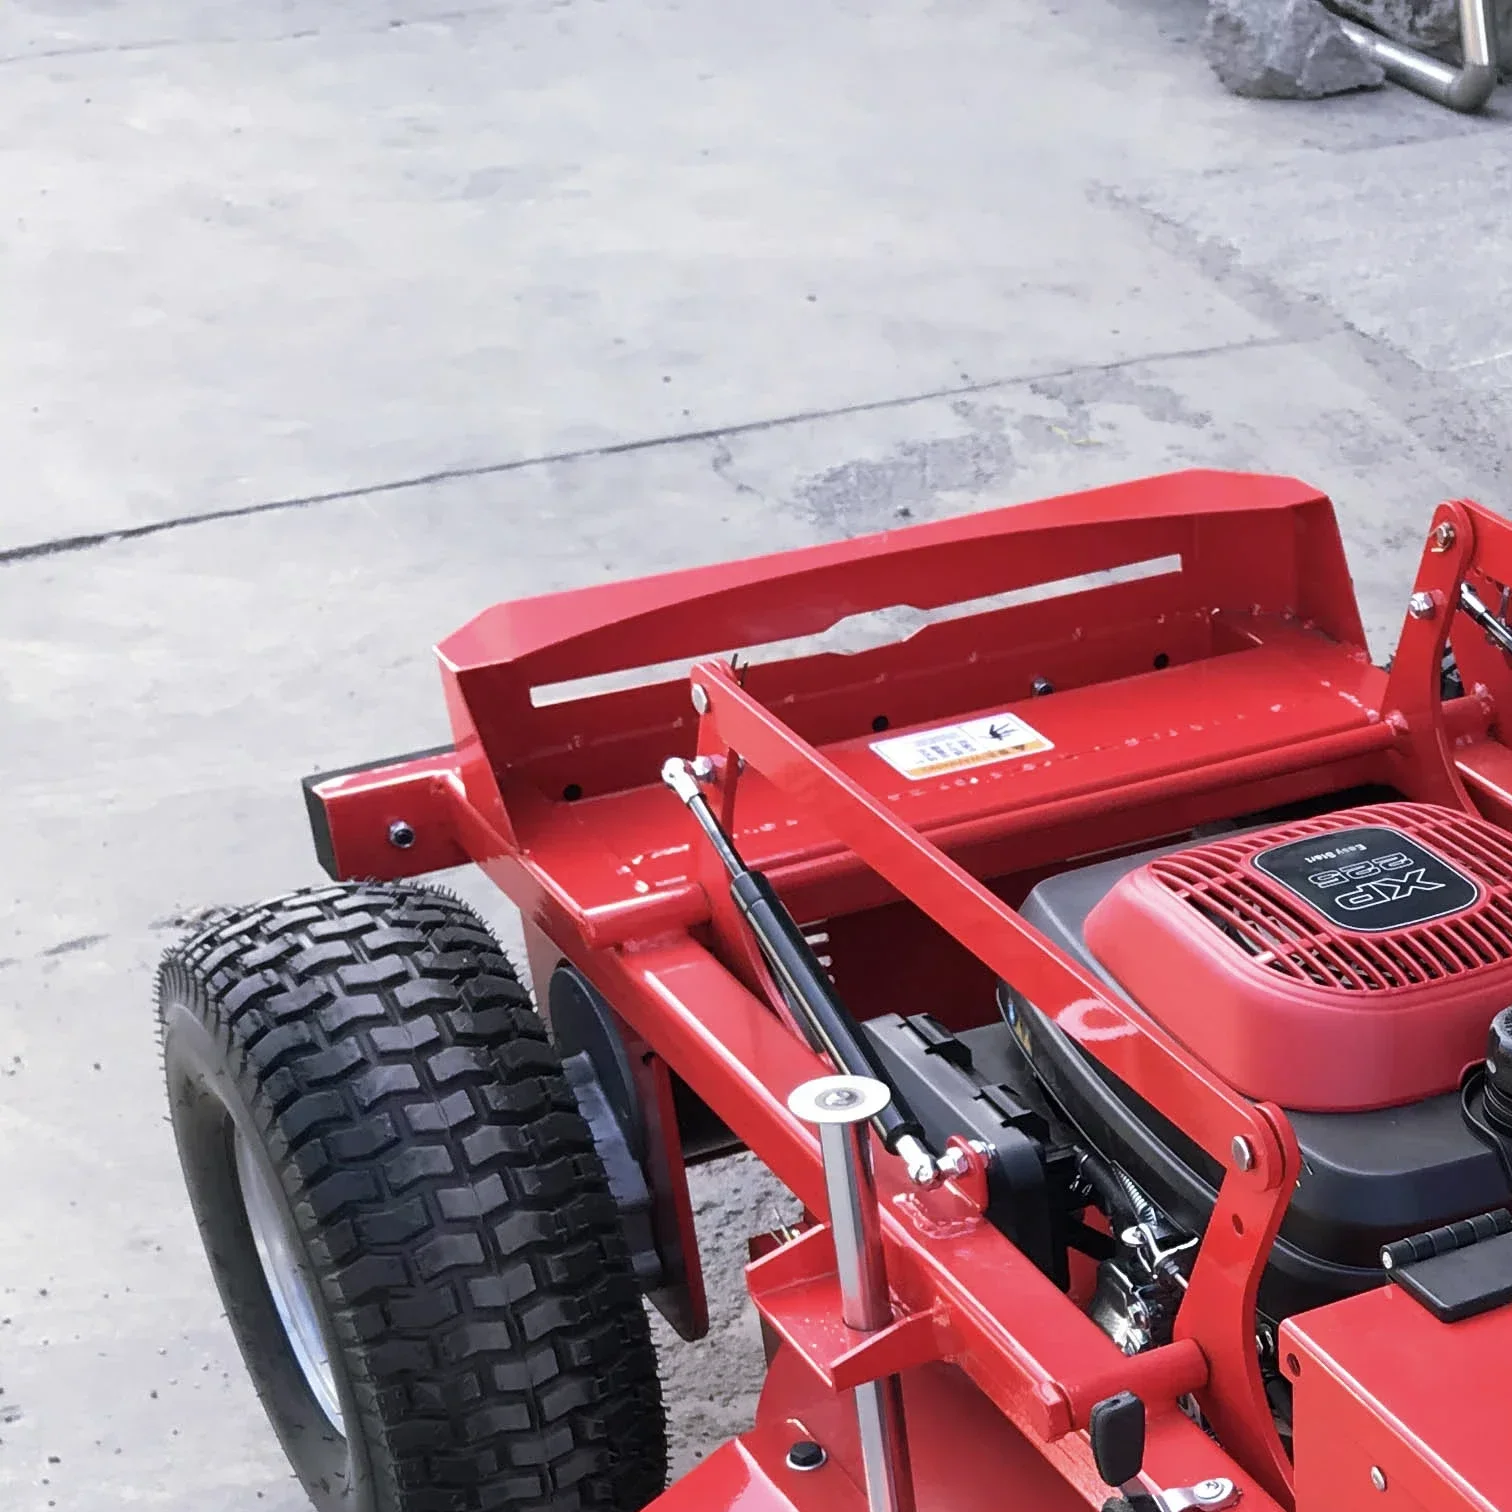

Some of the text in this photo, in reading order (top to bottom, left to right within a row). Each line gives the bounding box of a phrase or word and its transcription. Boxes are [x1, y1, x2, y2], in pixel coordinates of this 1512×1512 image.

[1335, 843, 1368, 856] Easy
[1307, 851, 1415, 889] 225
[1334, 867, 1446, 911] XP
